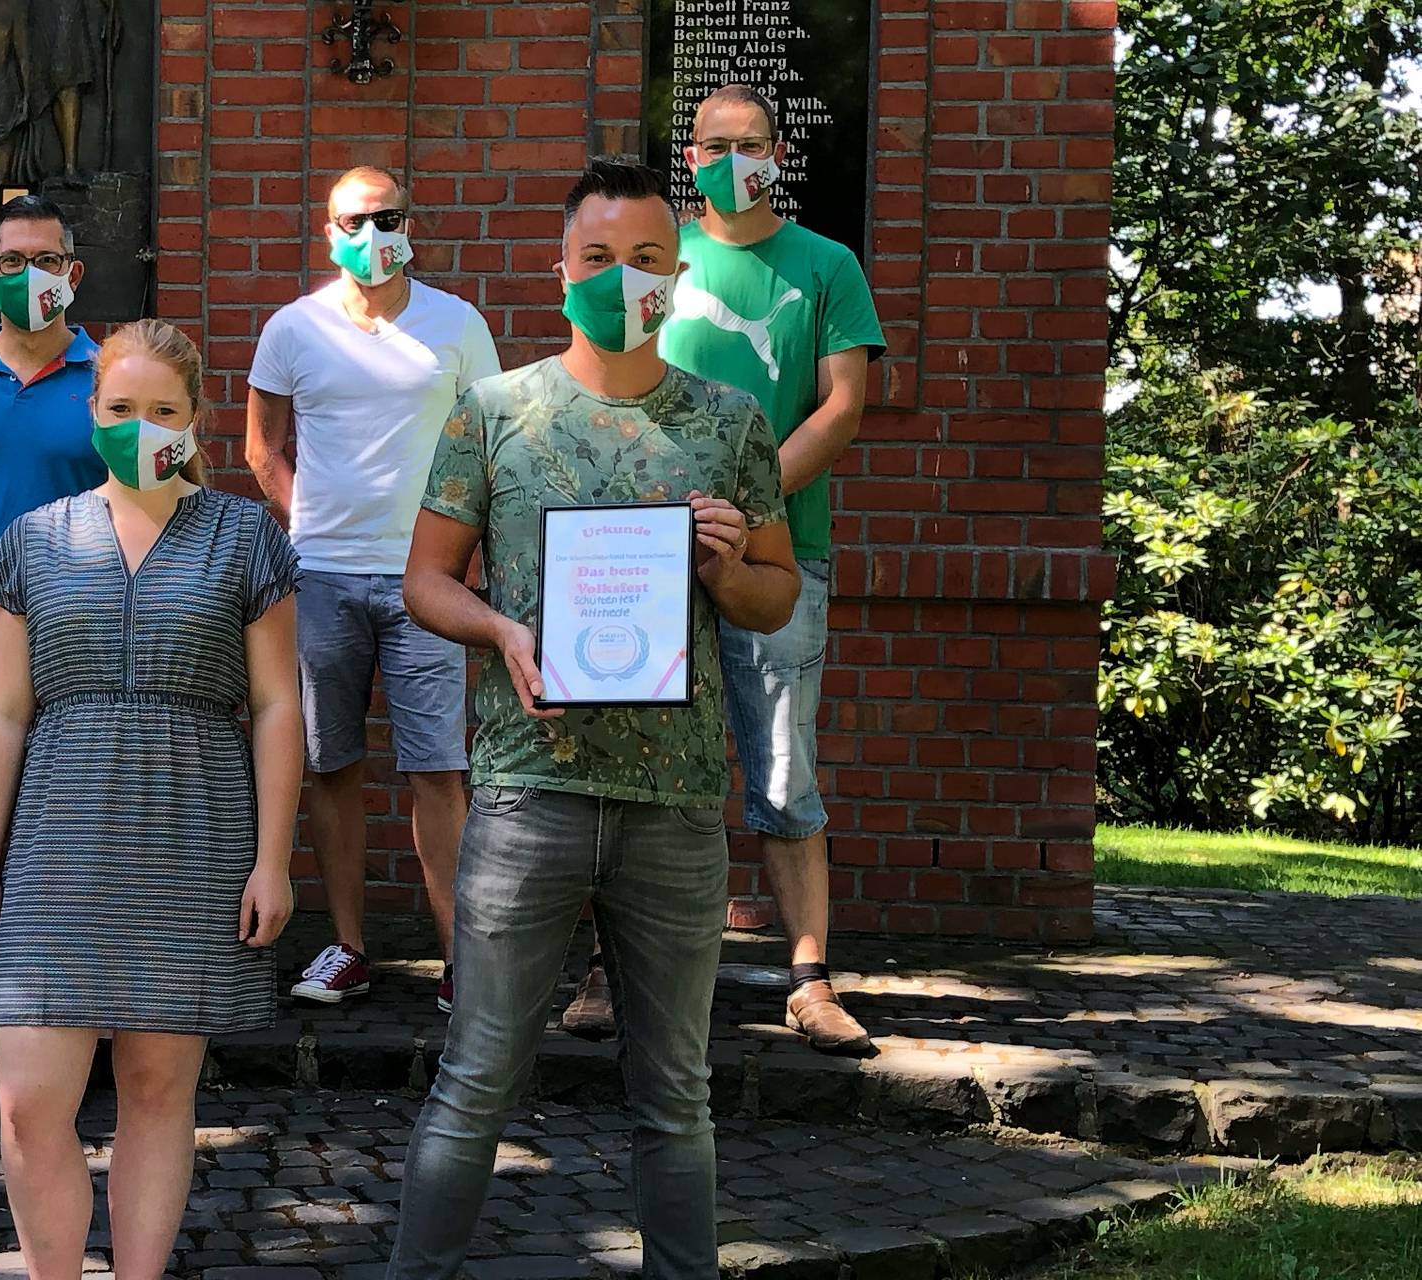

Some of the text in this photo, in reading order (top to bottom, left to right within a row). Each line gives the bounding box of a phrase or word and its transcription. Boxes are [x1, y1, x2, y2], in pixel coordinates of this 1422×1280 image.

[675, 0, 791, 13] Barbett Franz
[674, 13, 791, 27] Barbett Heinr.
[674, 27, 811, 41] Beckmann Gerh.
[674, 41, 786, 57] Beßling Alois
[673, 56, 787, 71] Ebbing Georg
[673, 69, 804, 85] Essingholt Joh.
[786, 98, 827, 110] Wilh.
[785, 112, 834, 124] Heinr.
[790, 127, 810, 140] Al.
[769, 198, 802, 210] Joh.
[582, 525, 651, 538] Urkunde
[577, 566, 650, 577] Das beste
[577, 583, 649, 593] Volksfest
